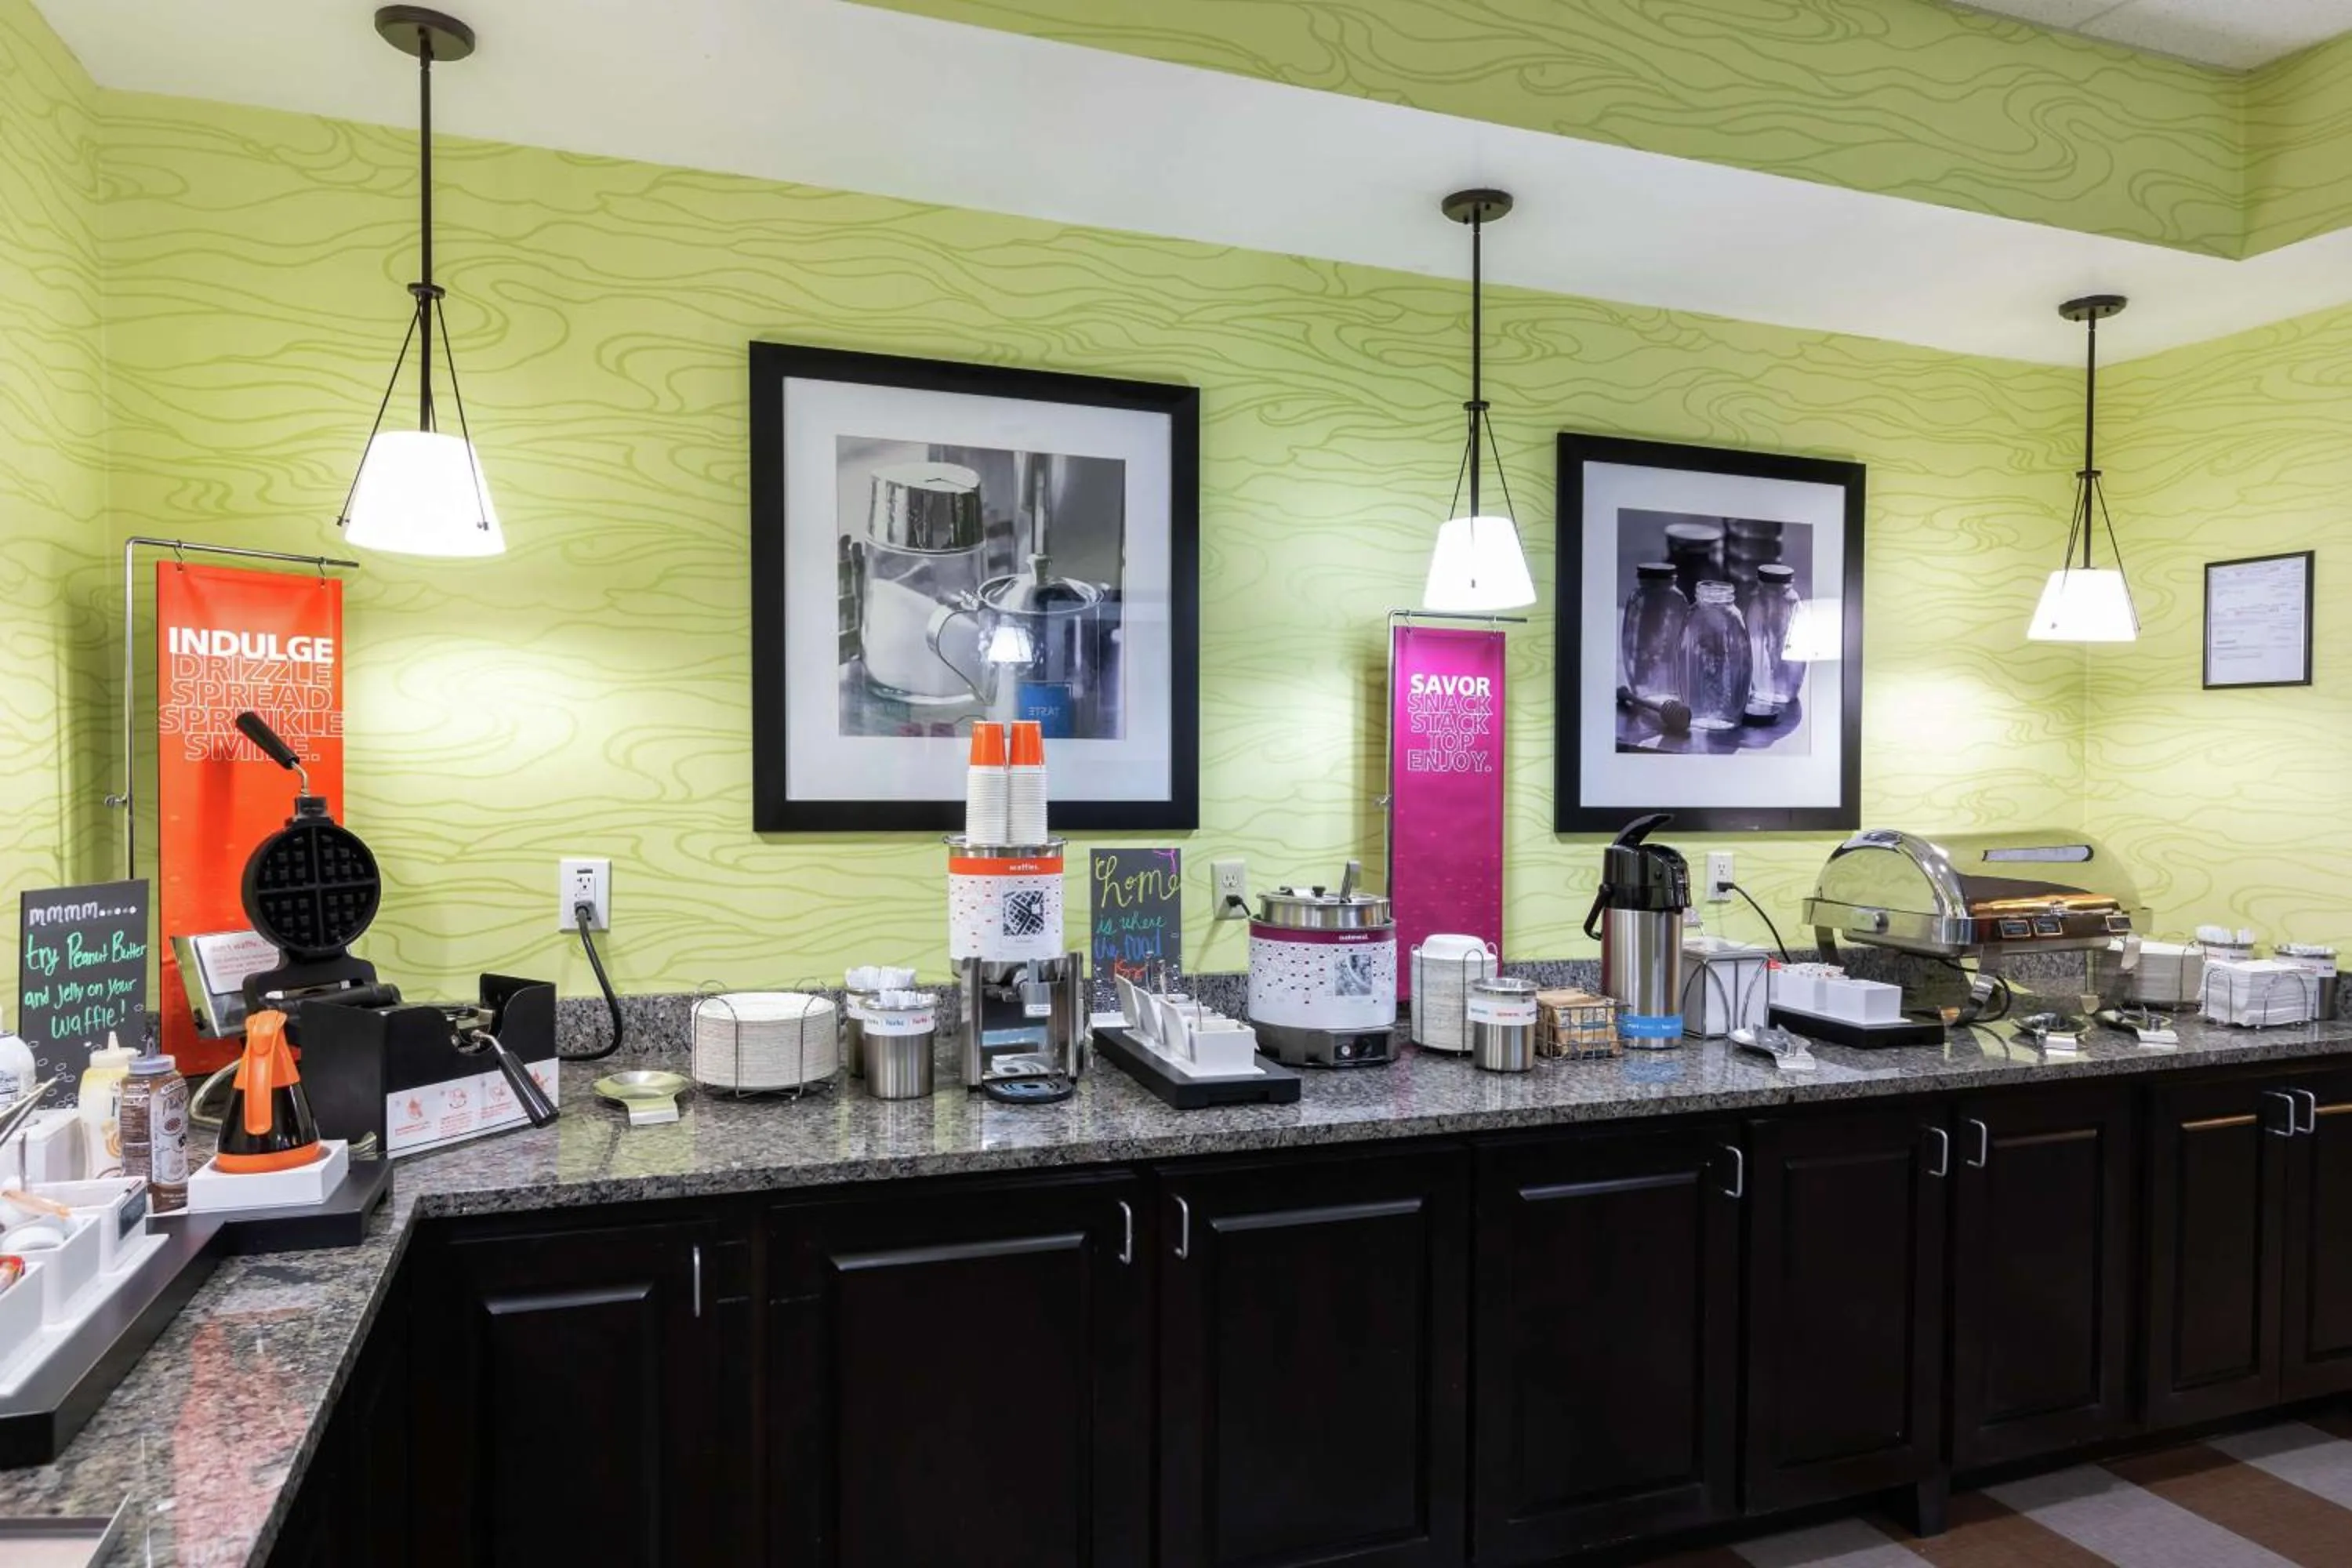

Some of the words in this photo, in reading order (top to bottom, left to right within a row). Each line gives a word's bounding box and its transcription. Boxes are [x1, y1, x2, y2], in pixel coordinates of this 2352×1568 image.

[168, 626, 335, 662] INDULGE
[171, 652, 332, 687] DRIZZLE
[1410, 673, 1490, 696] SAVOR
[170, 679, 333, 710] SPREAD
[1407, 693, 1493, 715] SNACK
[158, 704, 344, 737] SPRNKLE
[1410, 713, 1490, 735] STACK
[184, 732, 321, 761] SMIE.
[1427, 731, 1475, 753] TOP
[1407, 749, 1492, 771] ENJOY.
[1095, 855, 1181, 909] home
[1119, 911, 1167, 930] where
[26, 934, 60, 975] try
[67, 931, 108, 970] Peanut
[111, 930, 147, 963] Butter
[24, 985, 49, 1010] and
[87, 982, 103, 996] on
[107, 978, 138, 1002] your
[50, 999, 126, 1040] waffle!
